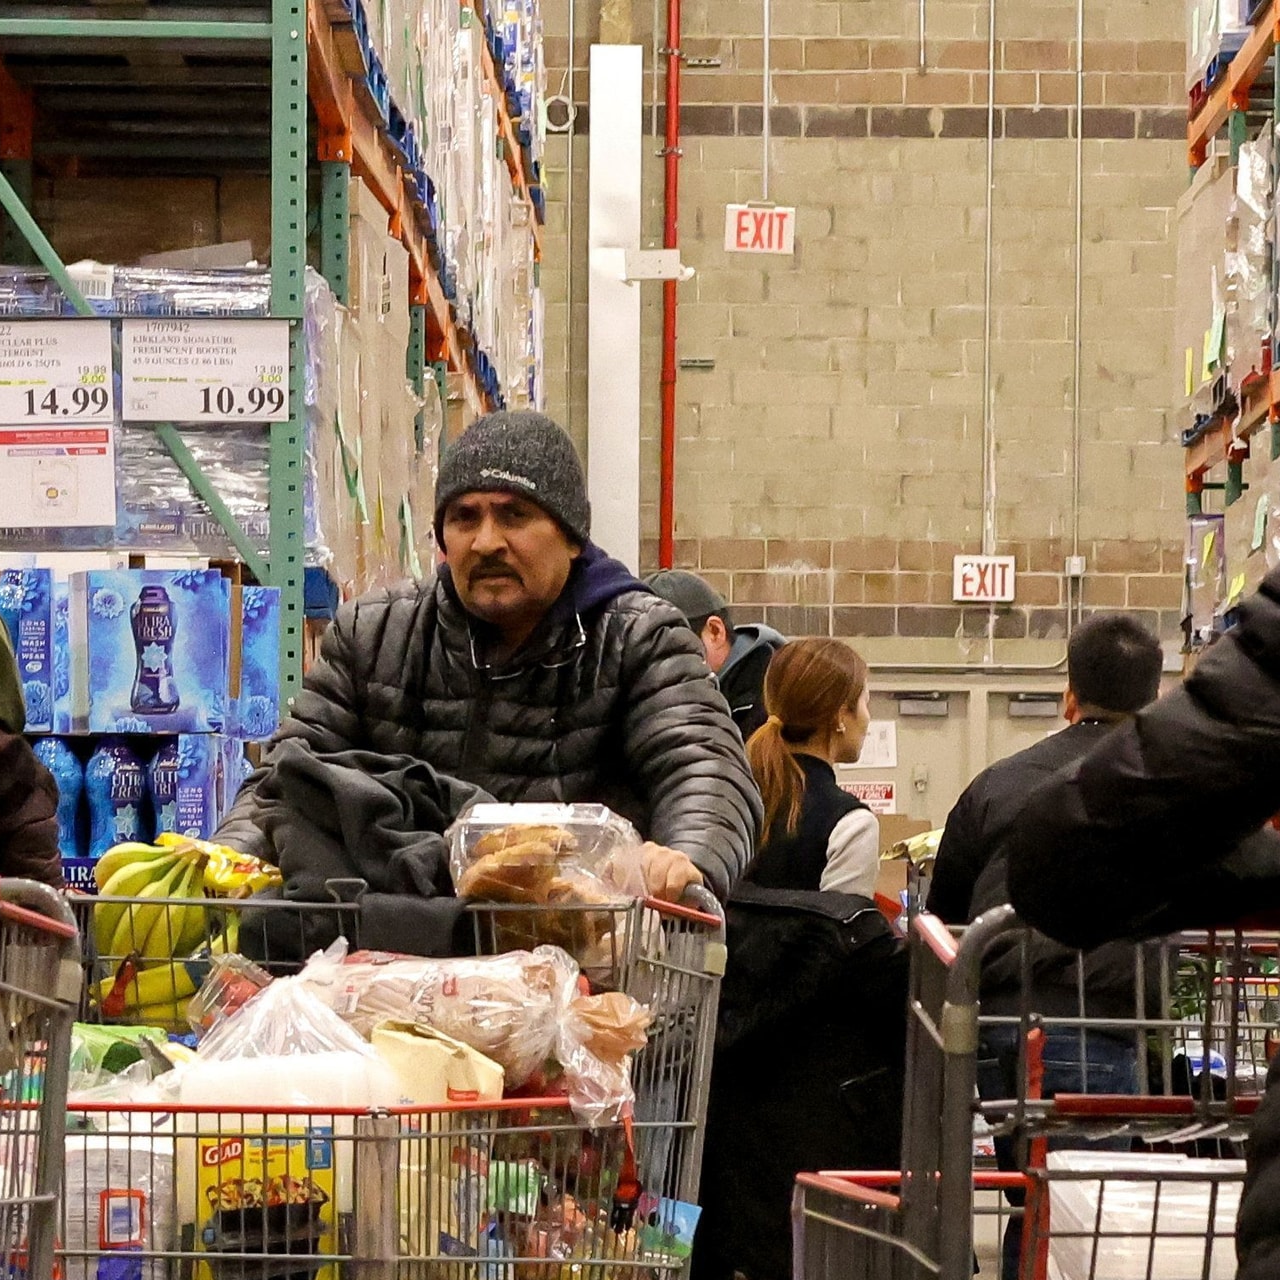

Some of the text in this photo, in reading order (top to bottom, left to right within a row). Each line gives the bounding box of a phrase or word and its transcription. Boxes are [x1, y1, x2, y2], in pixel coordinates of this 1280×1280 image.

[736, 211, 787, 249] EXIT
[146, 323, 190, 333] 1707942
[34, 338, 58, 346] PLUS
[132, 336, 234, 344] KIRKLAND SIGNATURE
[196, 346, 237, 354] BOOSTER
[77, 365, 107, 374] 19.99
[24, 387, 109, 416] 14.99
[199, 386, 285, 414] 10.99
[961, 562, 1009, 597] EXIT
[205, 1142, 242, 1164] GLAD
